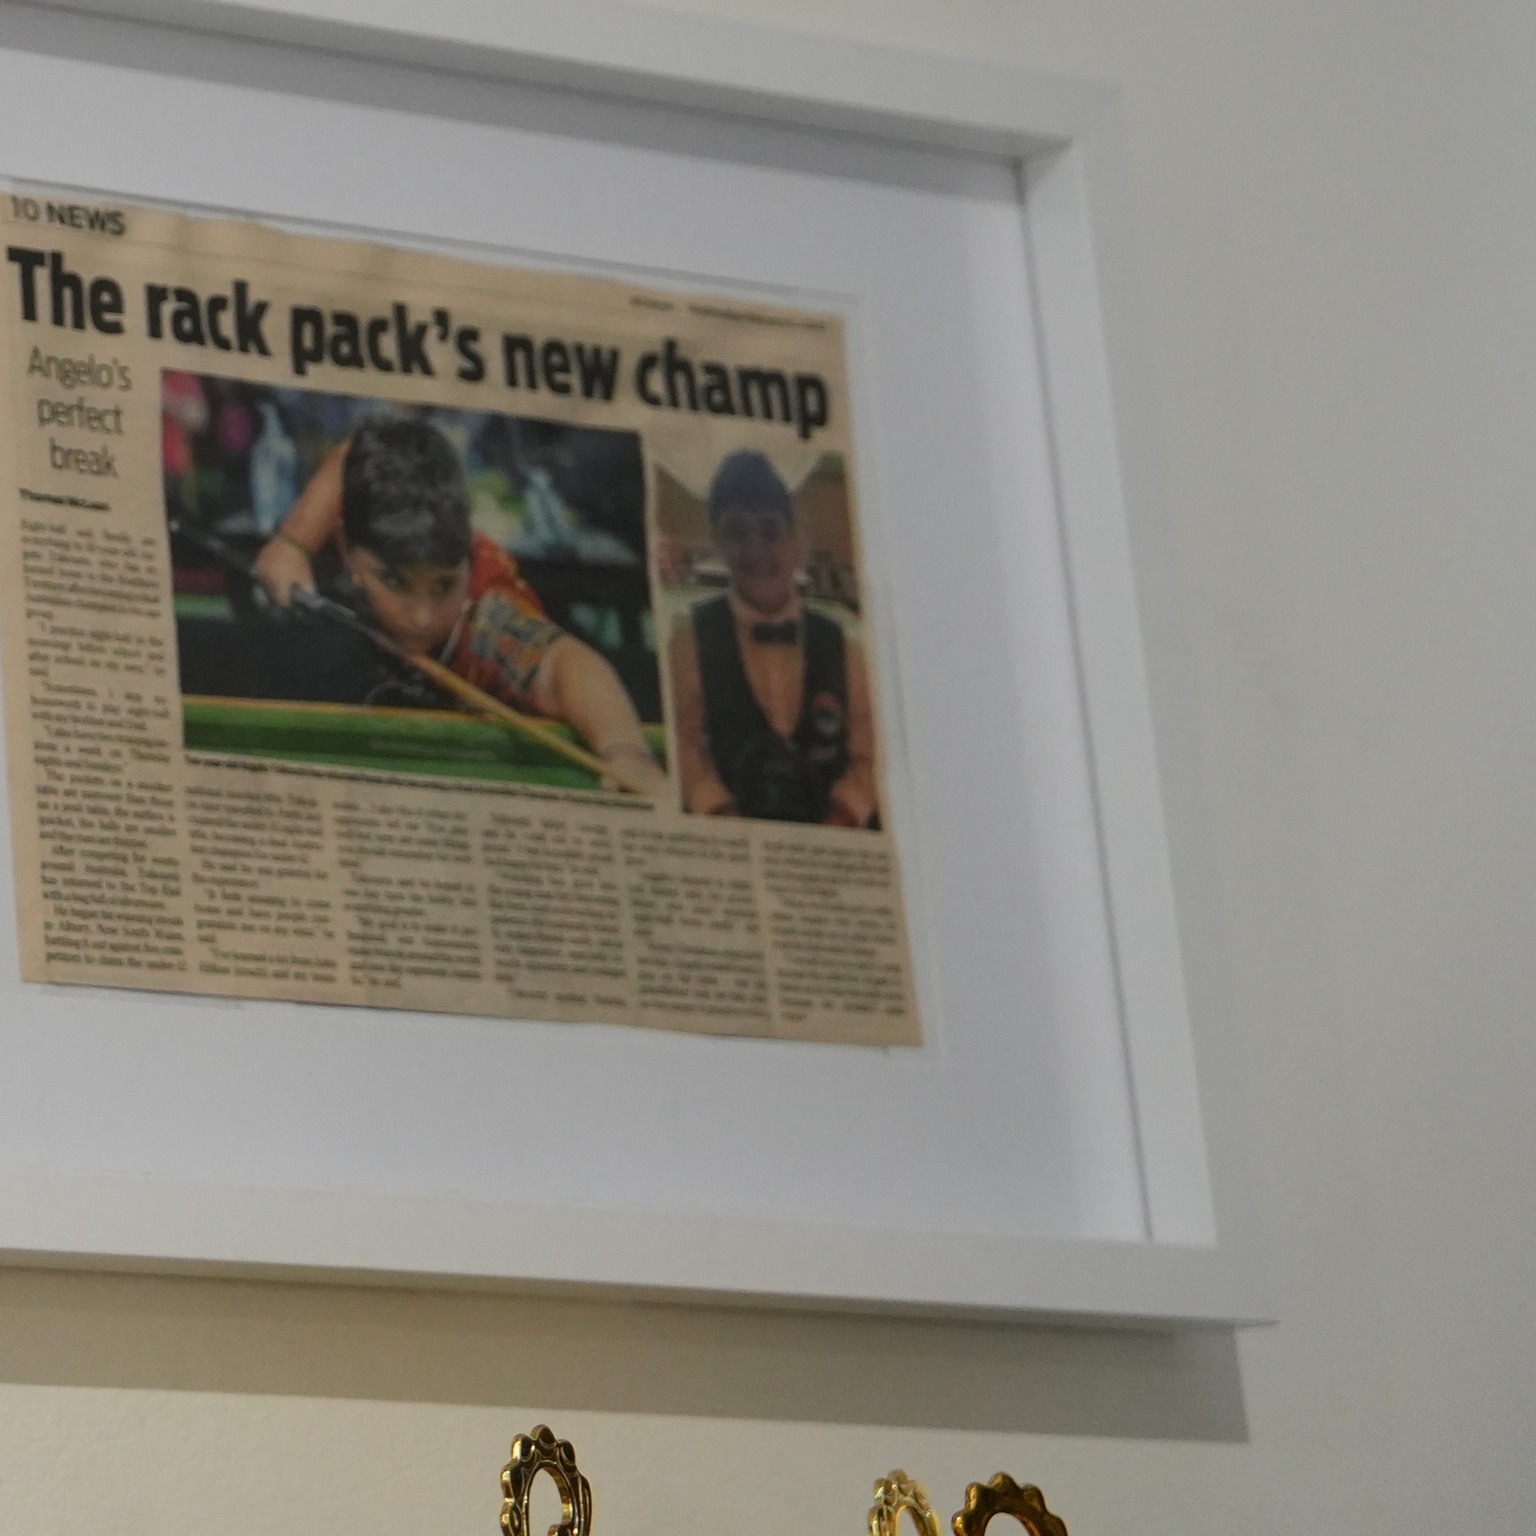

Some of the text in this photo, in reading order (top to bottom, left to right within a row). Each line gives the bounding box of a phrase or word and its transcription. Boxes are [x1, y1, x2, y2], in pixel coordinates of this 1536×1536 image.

[10, 195, 126, 237] 10 NEWS
[7, 246, 830, 438] The rack pack's new champ
[27, 344, 132, 394] Angelo's
[37, 390, 123, 438] perfect
[49, 438, 118, 479] break
